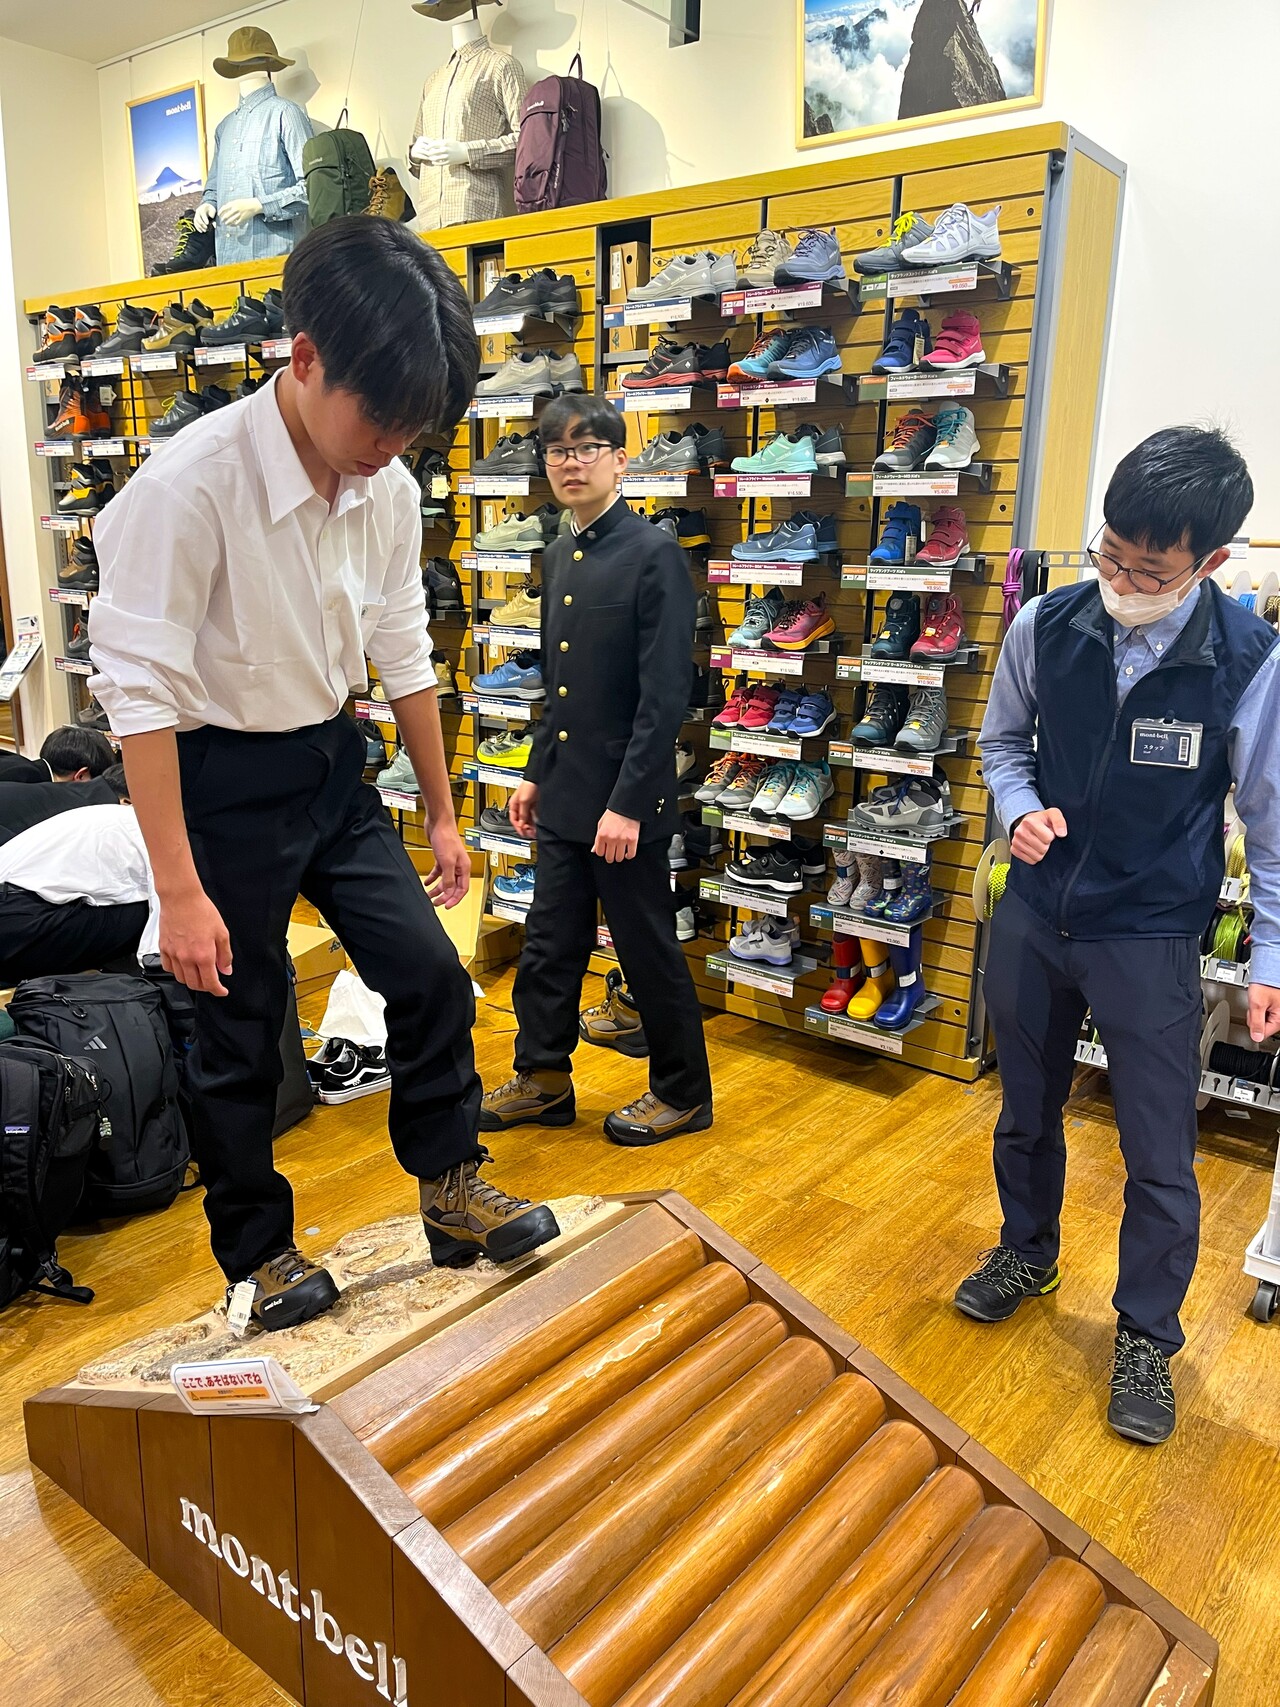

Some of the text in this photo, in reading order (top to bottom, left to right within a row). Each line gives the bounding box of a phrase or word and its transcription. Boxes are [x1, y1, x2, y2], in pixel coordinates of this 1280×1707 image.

[165, 100, 191, 116] mont-bell
[1140, 732, 1169, 740] mont-bell
[181, 1371, 263, 1389] ここで、あそばないでね
[179, 1496, 408, 1707] mont-bell
